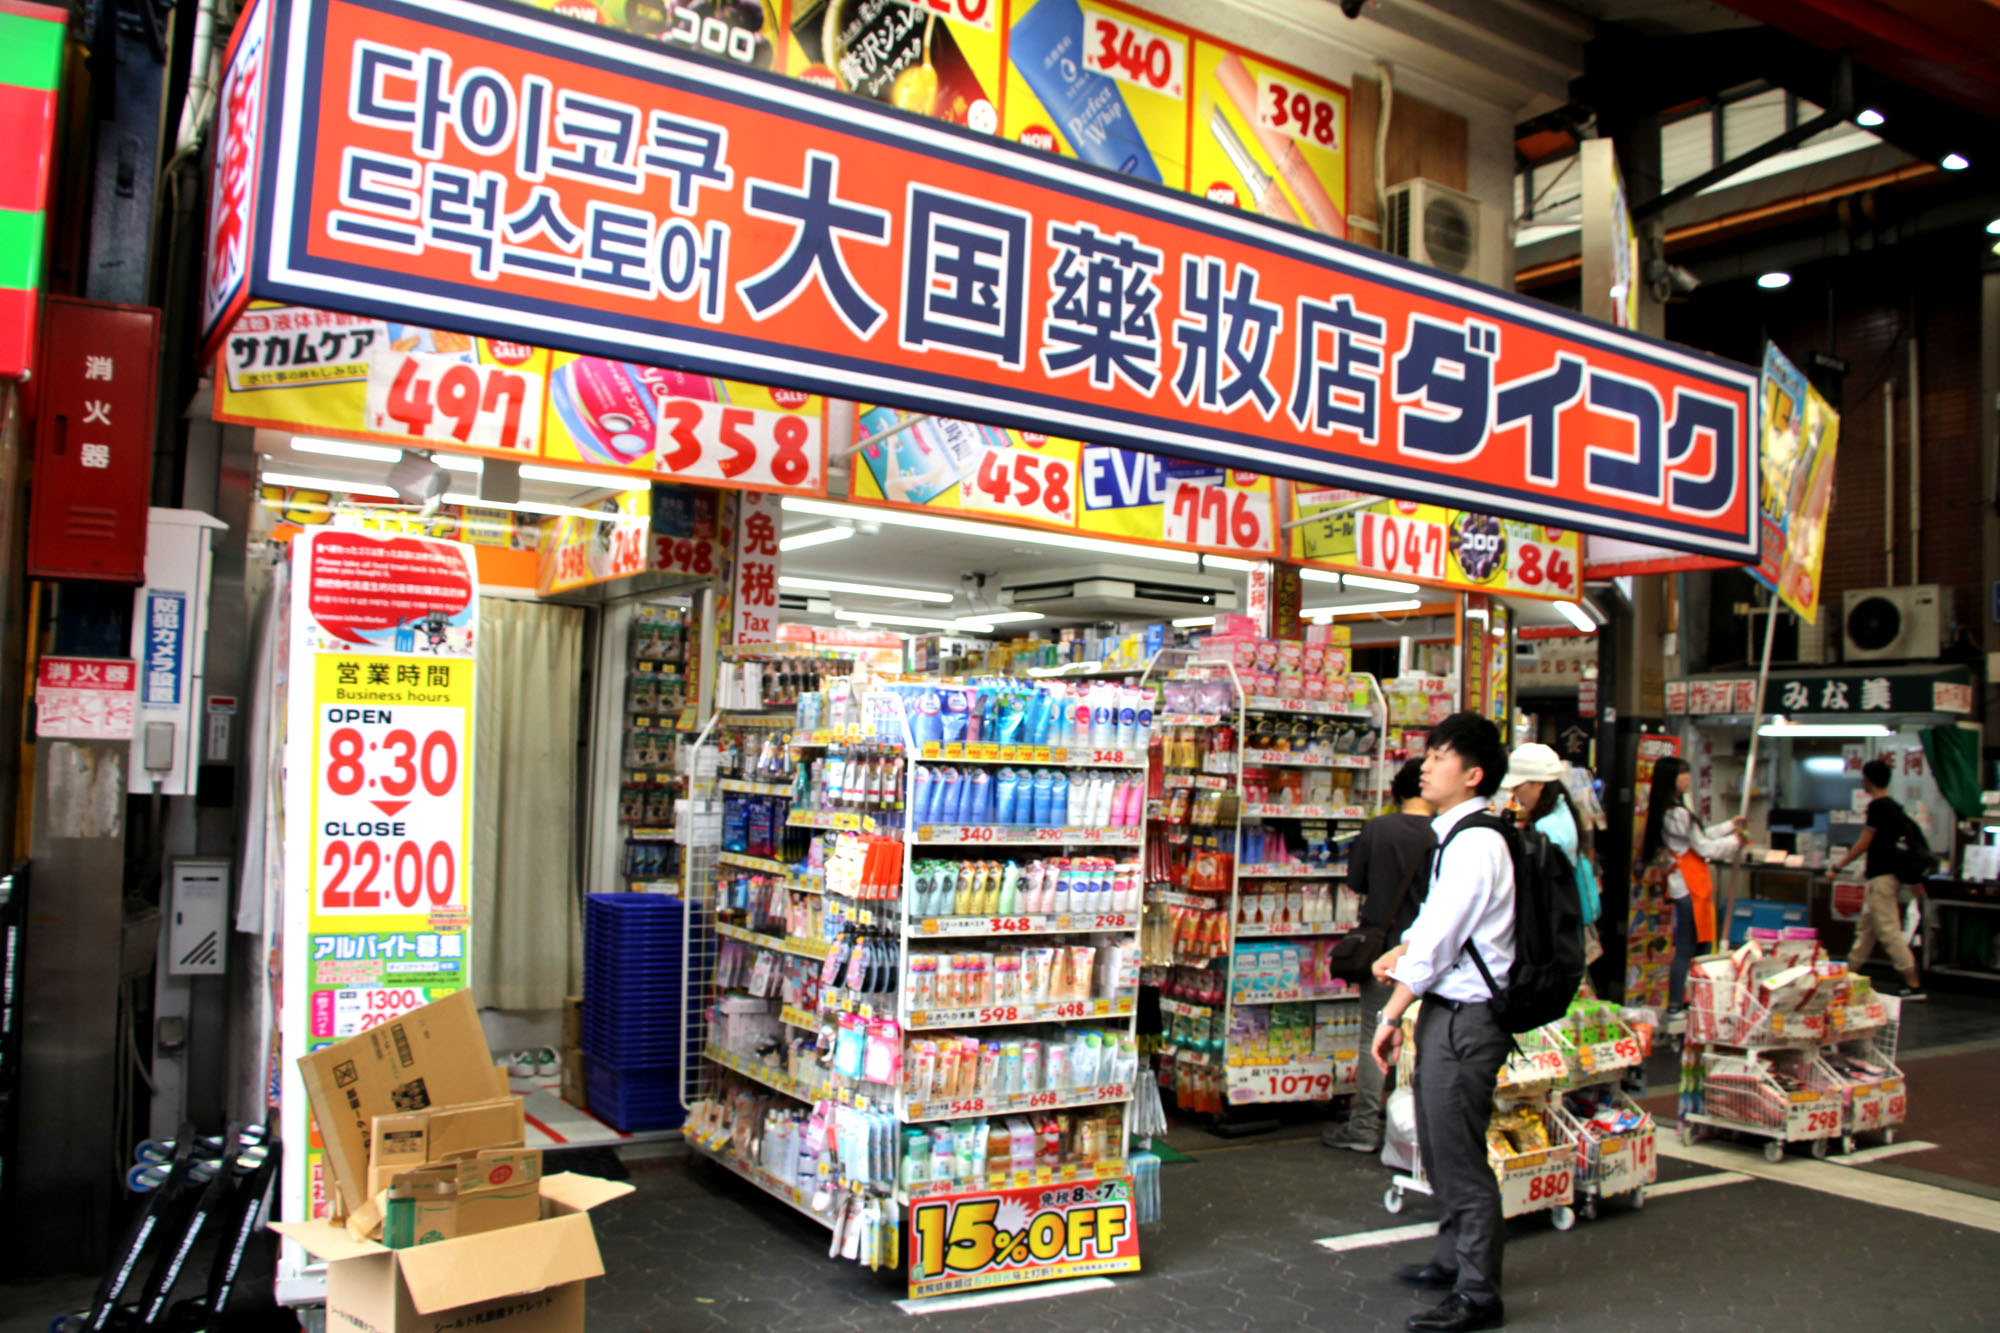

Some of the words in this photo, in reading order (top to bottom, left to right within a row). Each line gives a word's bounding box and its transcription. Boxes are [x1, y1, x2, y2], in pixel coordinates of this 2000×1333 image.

[1096, 19, 1172, 89] 340
[350, 39, 733, 216] 다이코쿠
[1068, 86, 1112, 146] Perfect
[1085, 101, 1122, 145] Whip
[1269, 83, 1334, 146] 398
[327, 146, 731, 324] 드럭스토어
[230, 329, 376, 369] サカムケア
[81, 356, 114, 469] 消火器
[386, 356, 525, 448] 497
[663, 400, 809, 486] 358
[976, 450, 1070, 515] 458
[1173, 482, 1260, 548] 776
[656, 537, 713, 575] 398
[741, 510, 777, 607] 免税
[1361, 514, 1443, 578] 1047
[1517, 544, 1574, 589] 84
[742, 611, 770, 632] Tax
[47, 662, 130, 682] 消火器
[337, 661, 450, 688] 営業時間
[336, 688, 402, 701] Business
[408, 690, 451, 702] hours
[328, 709, 392, 724] OPEN
[326, 727, 458, 797] 8:30
[1093, 750, 1124, 763] 348
[324, 821, 406, 836] CLOSE
[959, 827, 993, 842] 340
[322, 840, 455, 907] 22:00
[989, 917, 1031, 932] 348
[1095, 914, 1125, 927] 298
[366, 990, 415, 1010] 1300
[979, 1006, 1018, 1023] 598
[1057, 1003, 1085, 1017] 498
[1614, 1039, 1637, 1058] 95
[1098, 1086, 1124, 1099] 598
[1269, 1074, 1331, 1095] 1079
[951, 1099, 984, 1114] 548
[1030, 1093, 1057, 1107] 698
[1808, 1111, 1838, 1132] 298
[1529, 1171, 1569, 1201] 880
[916, 1199, 1127, 1278] 15%OFF
